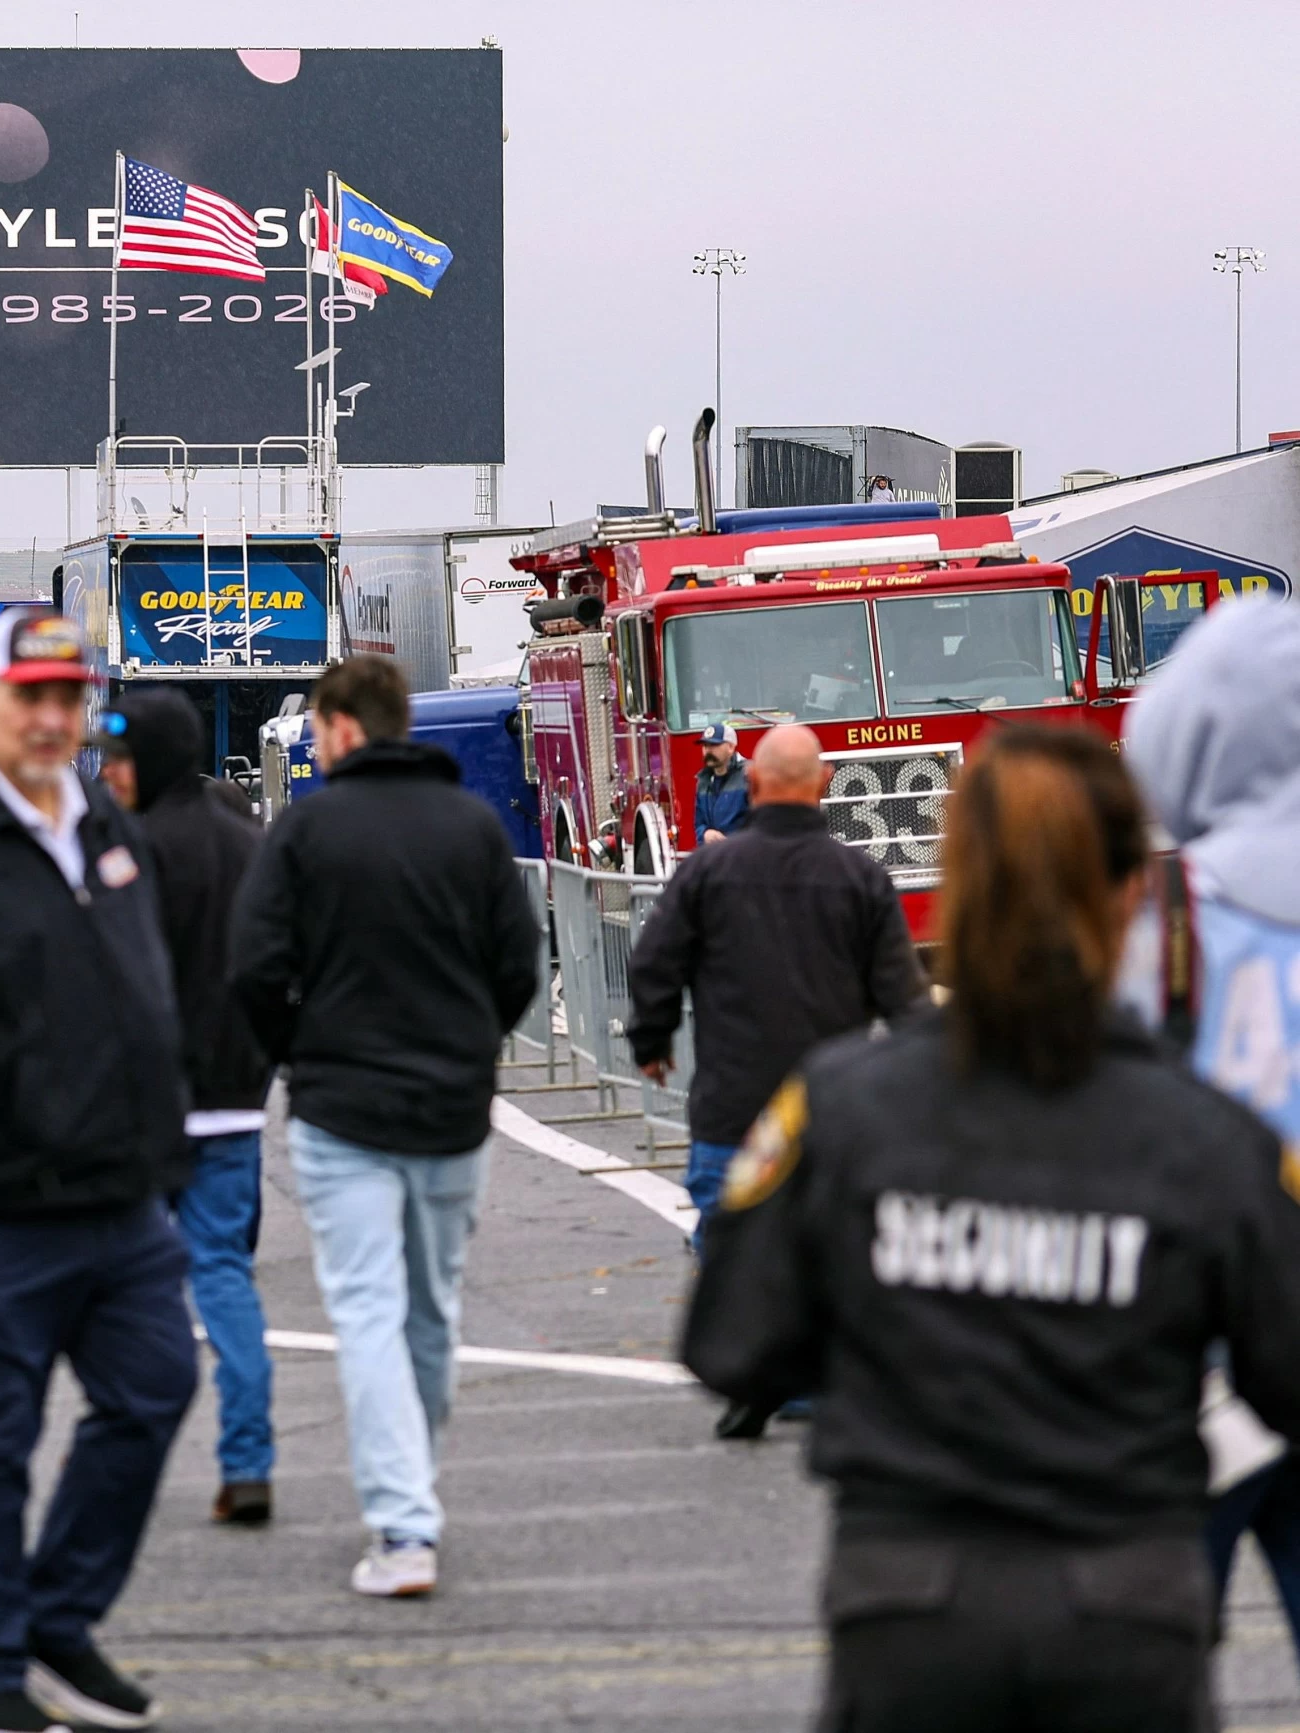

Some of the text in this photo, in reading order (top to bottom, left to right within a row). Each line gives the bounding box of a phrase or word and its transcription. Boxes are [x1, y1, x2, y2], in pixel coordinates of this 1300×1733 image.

[488, 577, 539, 590] Forward
[866, 577, 882, 587] the
[140, 590, 305, 610] GOODYEAR
[154, 613, 284, 647] Racing
[847, 724, 923, 745] ENGINE
[290, 763, 313, 779] 52
[828, 757, 950, 866] 33
[870, 1190, 1146, 1308] SECURITY
